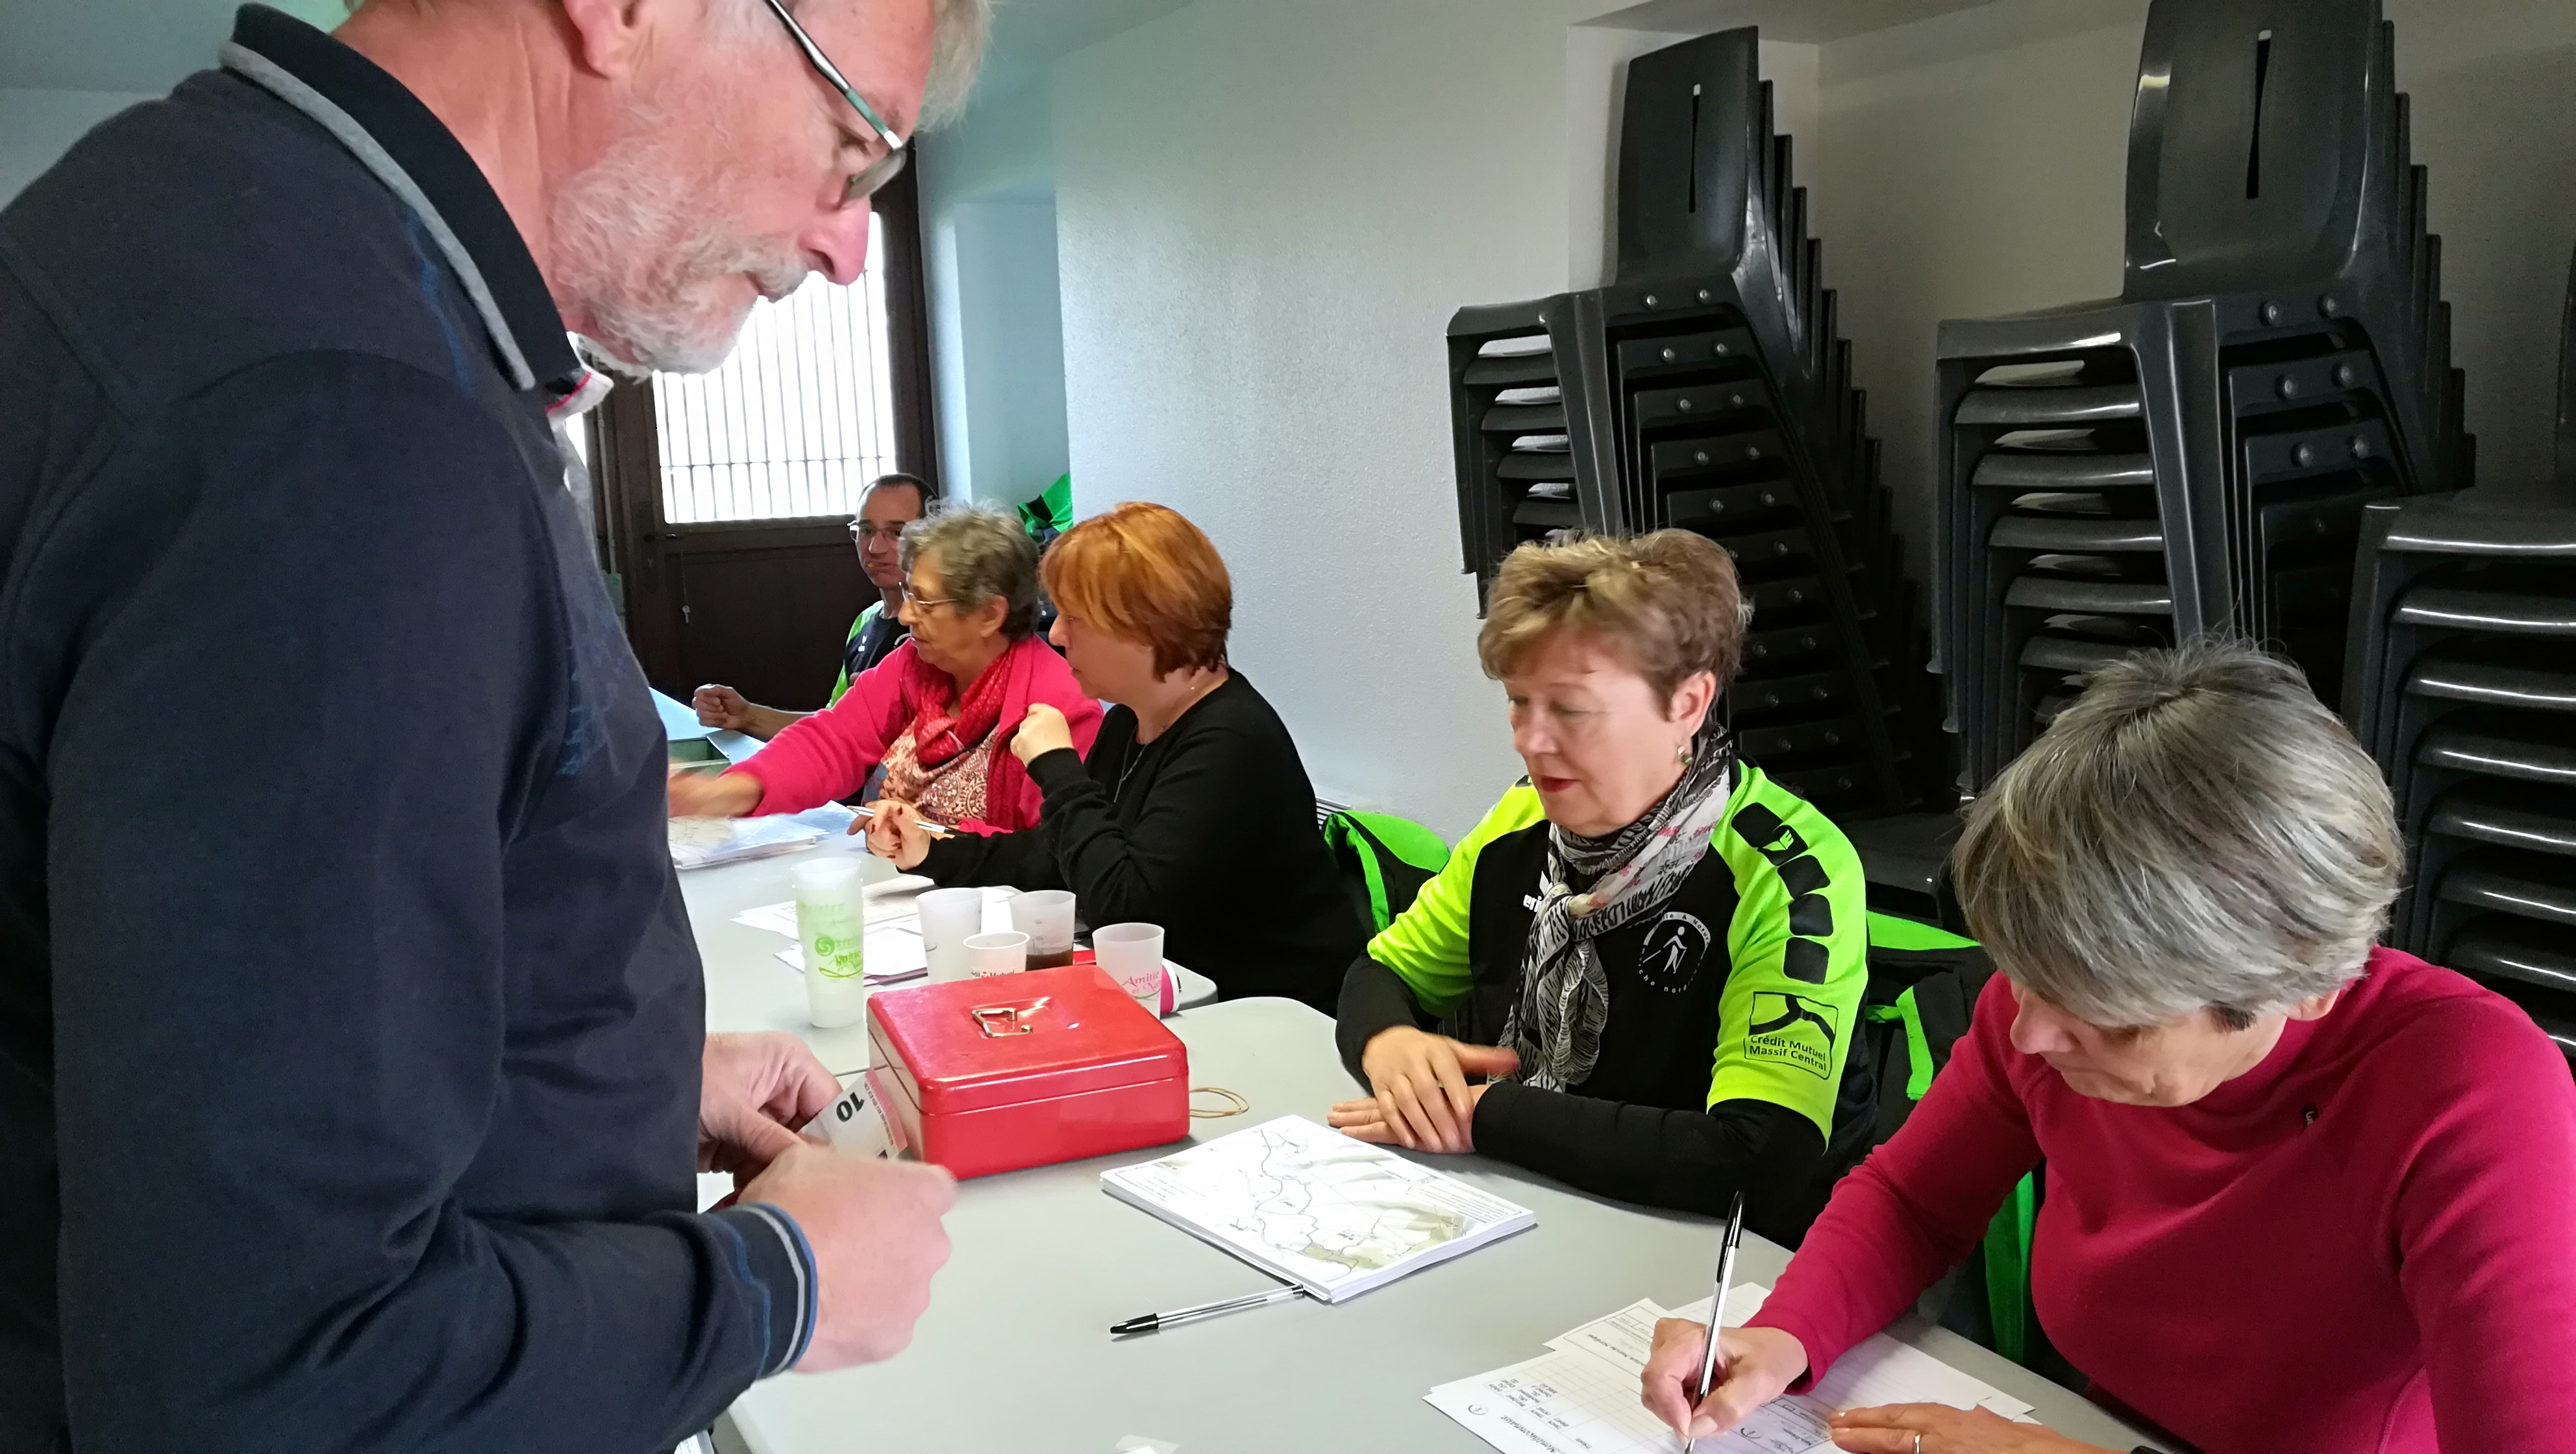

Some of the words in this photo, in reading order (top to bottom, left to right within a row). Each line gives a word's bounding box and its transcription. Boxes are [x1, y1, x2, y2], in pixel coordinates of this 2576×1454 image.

[1523, 894, 1542, 913] eri
[1750, 1035, 1786, 1047] Crédit
[1789, 1041, 1826, 1061] Mutuel
[1750, 1046, 1787, 1056] Massif
[1790, 1050, 1826, 1071] Central
[836, 1092, 865, 1122] 10
